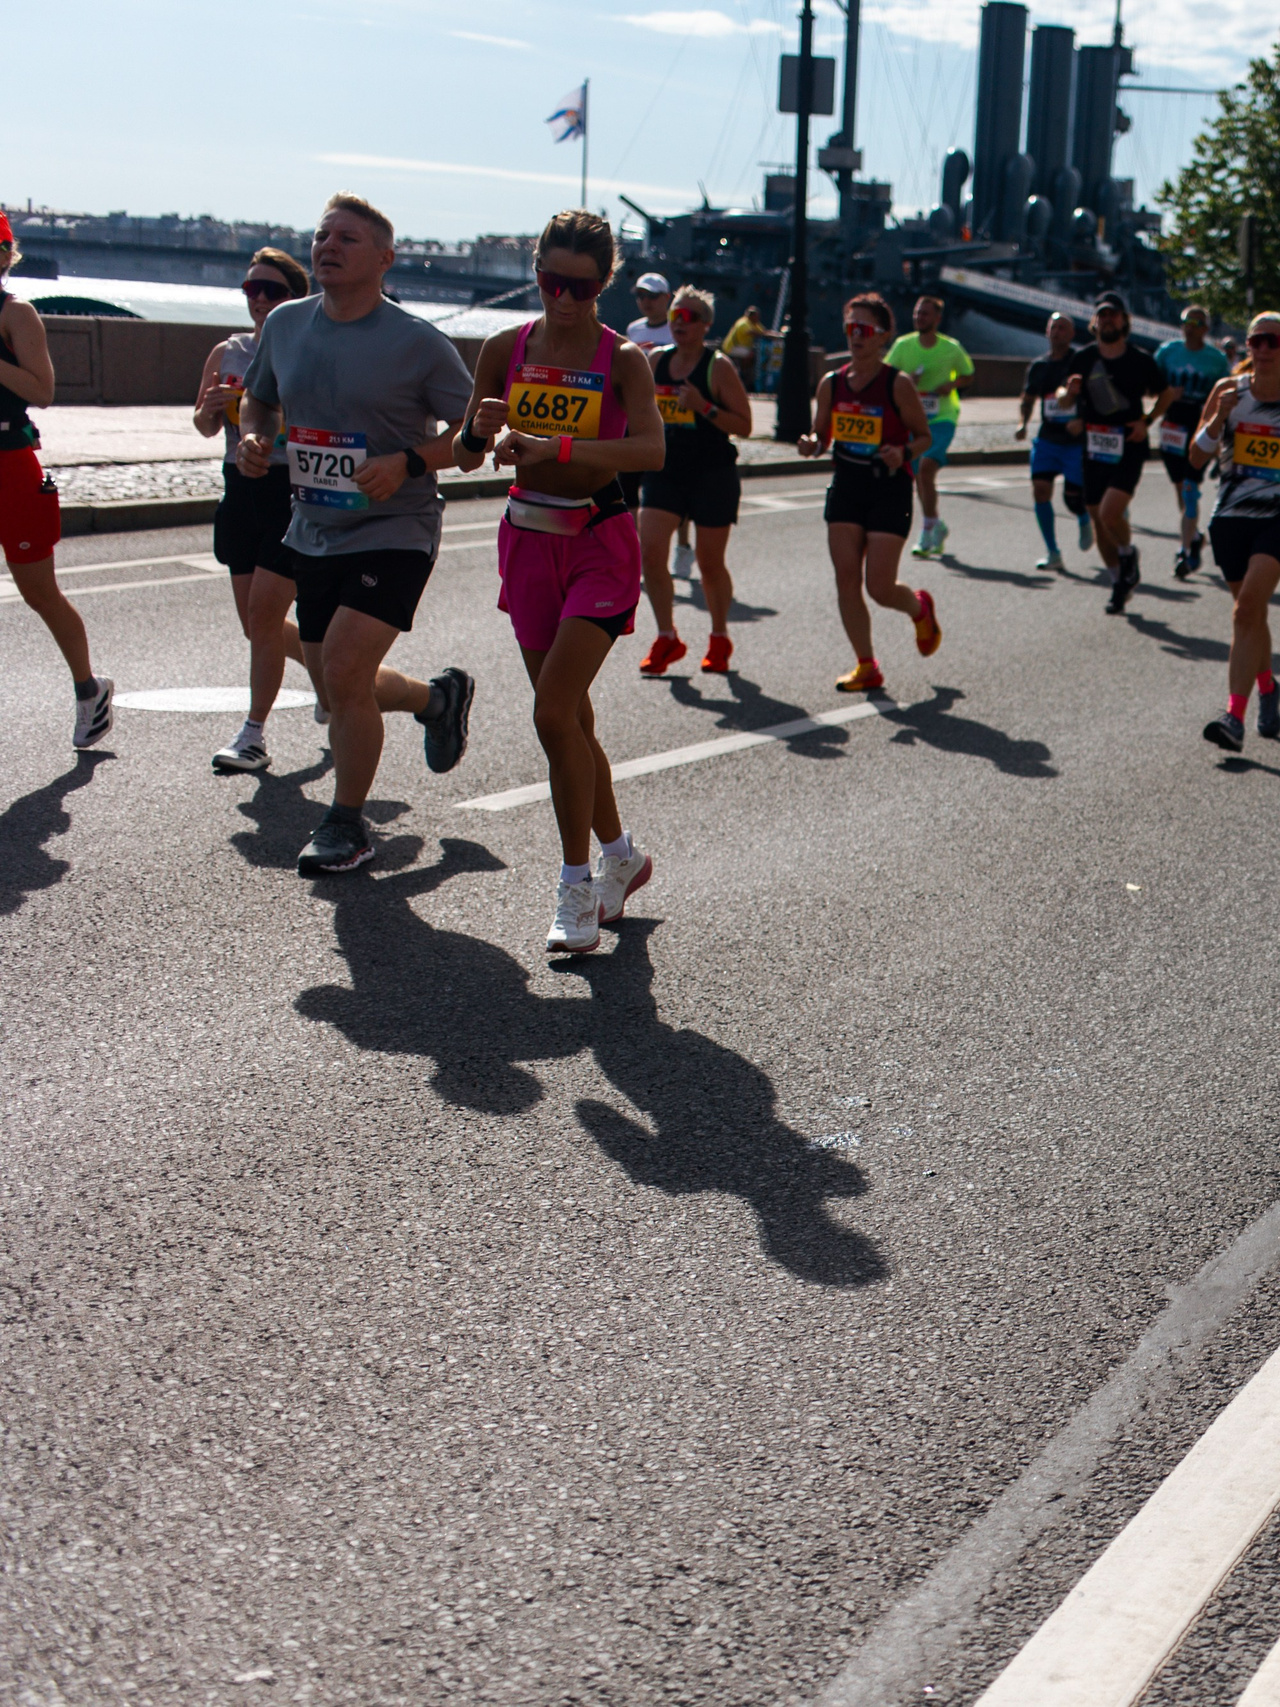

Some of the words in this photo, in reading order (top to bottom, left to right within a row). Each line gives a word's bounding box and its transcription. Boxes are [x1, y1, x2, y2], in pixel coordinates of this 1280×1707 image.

[562, 374, 577, 384] 21,1
[517, 390, 588, 423] 6687
[521, 420, 579, 433] СТАНИСЛАВА
[837, 416, 875, 435] 5793
[329, 435, 341, 445] 21,1
[1245, 440, 1280, 459] 439
[296, 449, 355, 478] 5720
[313, 476, 338, 487] ПАВЕЛ
[298, 487, 306, 501] E
